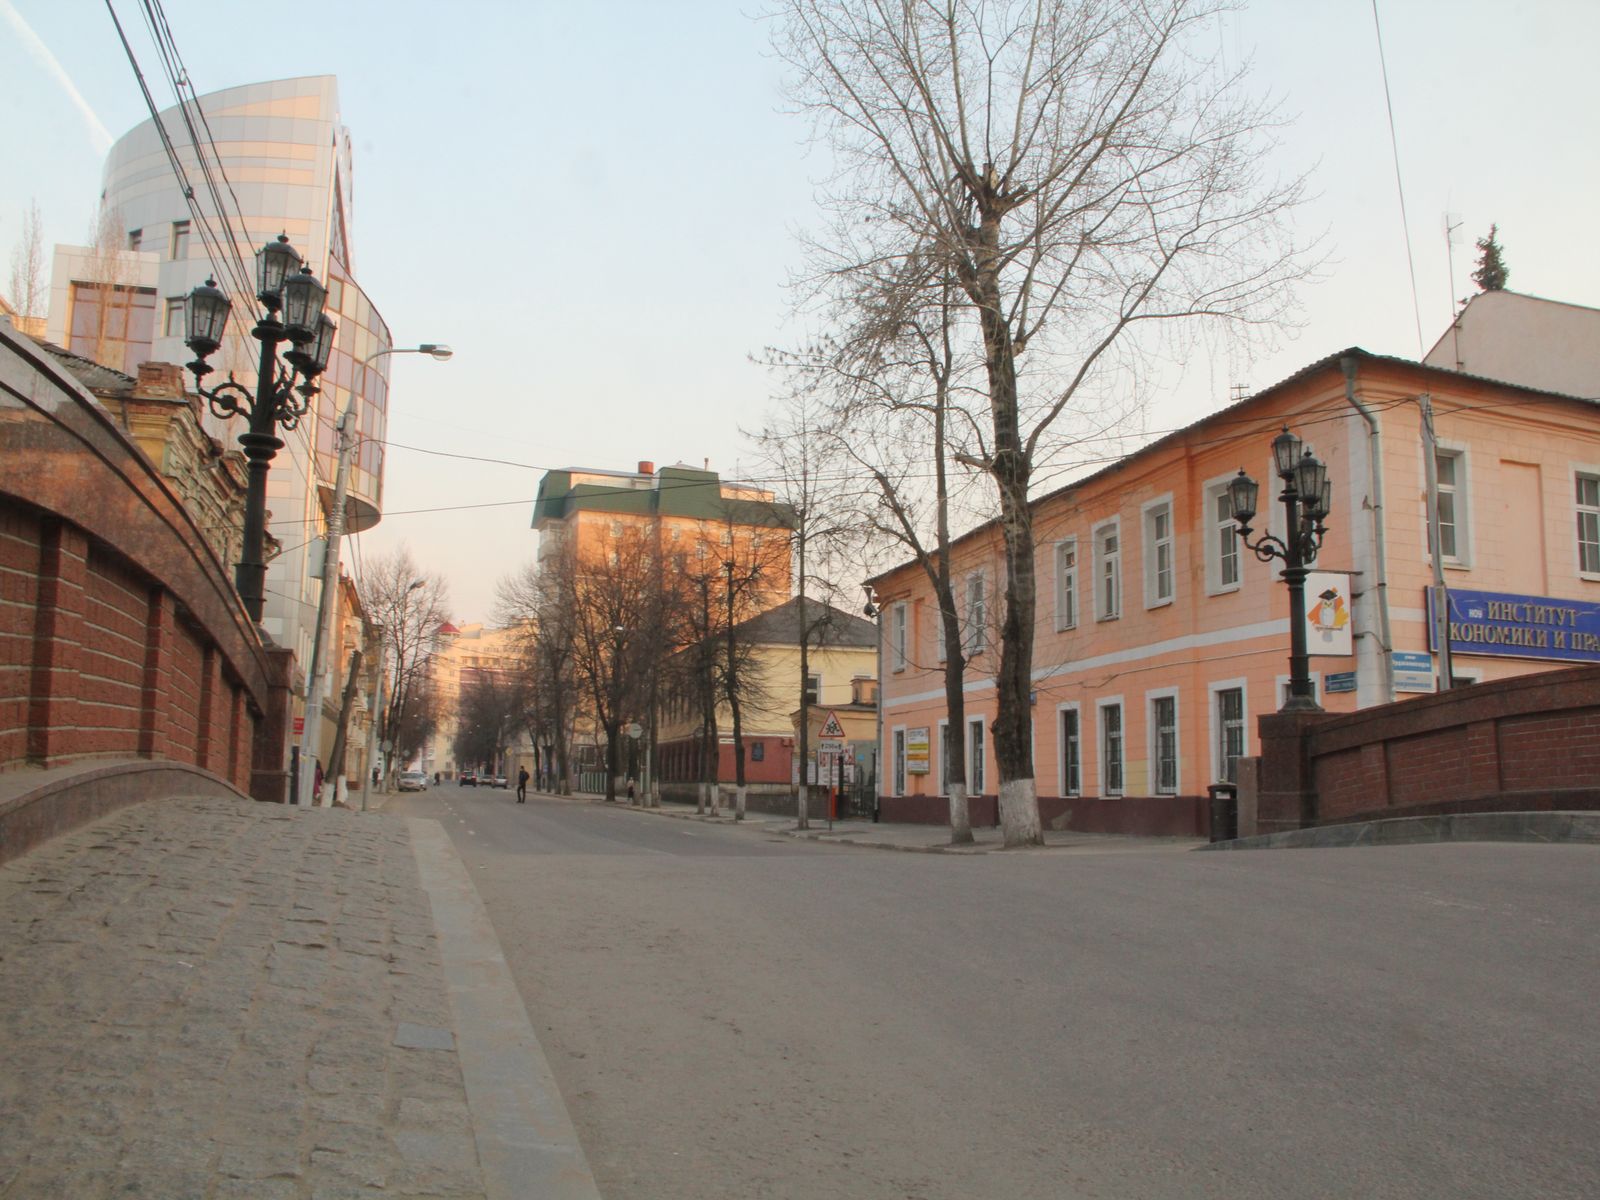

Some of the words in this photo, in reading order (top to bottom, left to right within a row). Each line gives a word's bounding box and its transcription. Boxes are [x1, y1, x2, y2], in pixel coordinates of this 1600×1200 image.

[1487, 600, 1577, 627] ИНСТИТУТ
[1449, 622, 1548, 648] КОНОМИКИ
[1554, 630, 1566, 649] И
